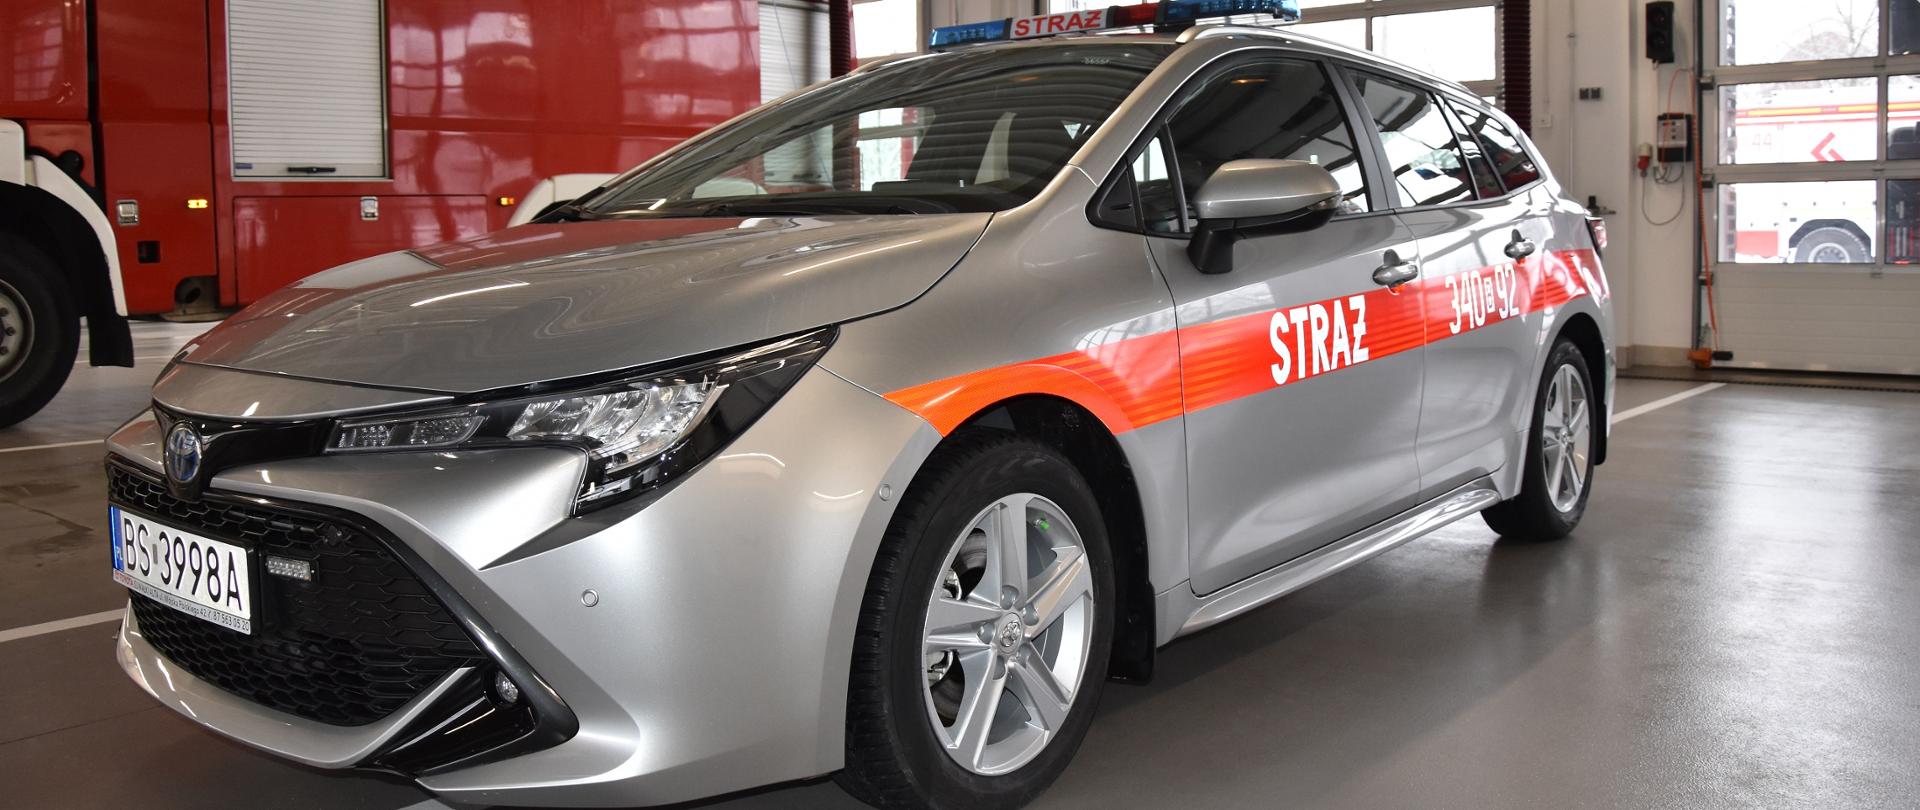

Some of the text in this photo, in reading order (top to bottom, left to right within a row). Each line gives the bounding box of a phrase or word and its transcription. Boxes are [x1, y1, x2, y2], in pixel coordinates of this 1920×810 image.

[1014, 10, 1103, 36] STRAŻ
[1269, 294, 1369, 385] STRAŻ
[124, 518, 242, 611] BS 3998A
